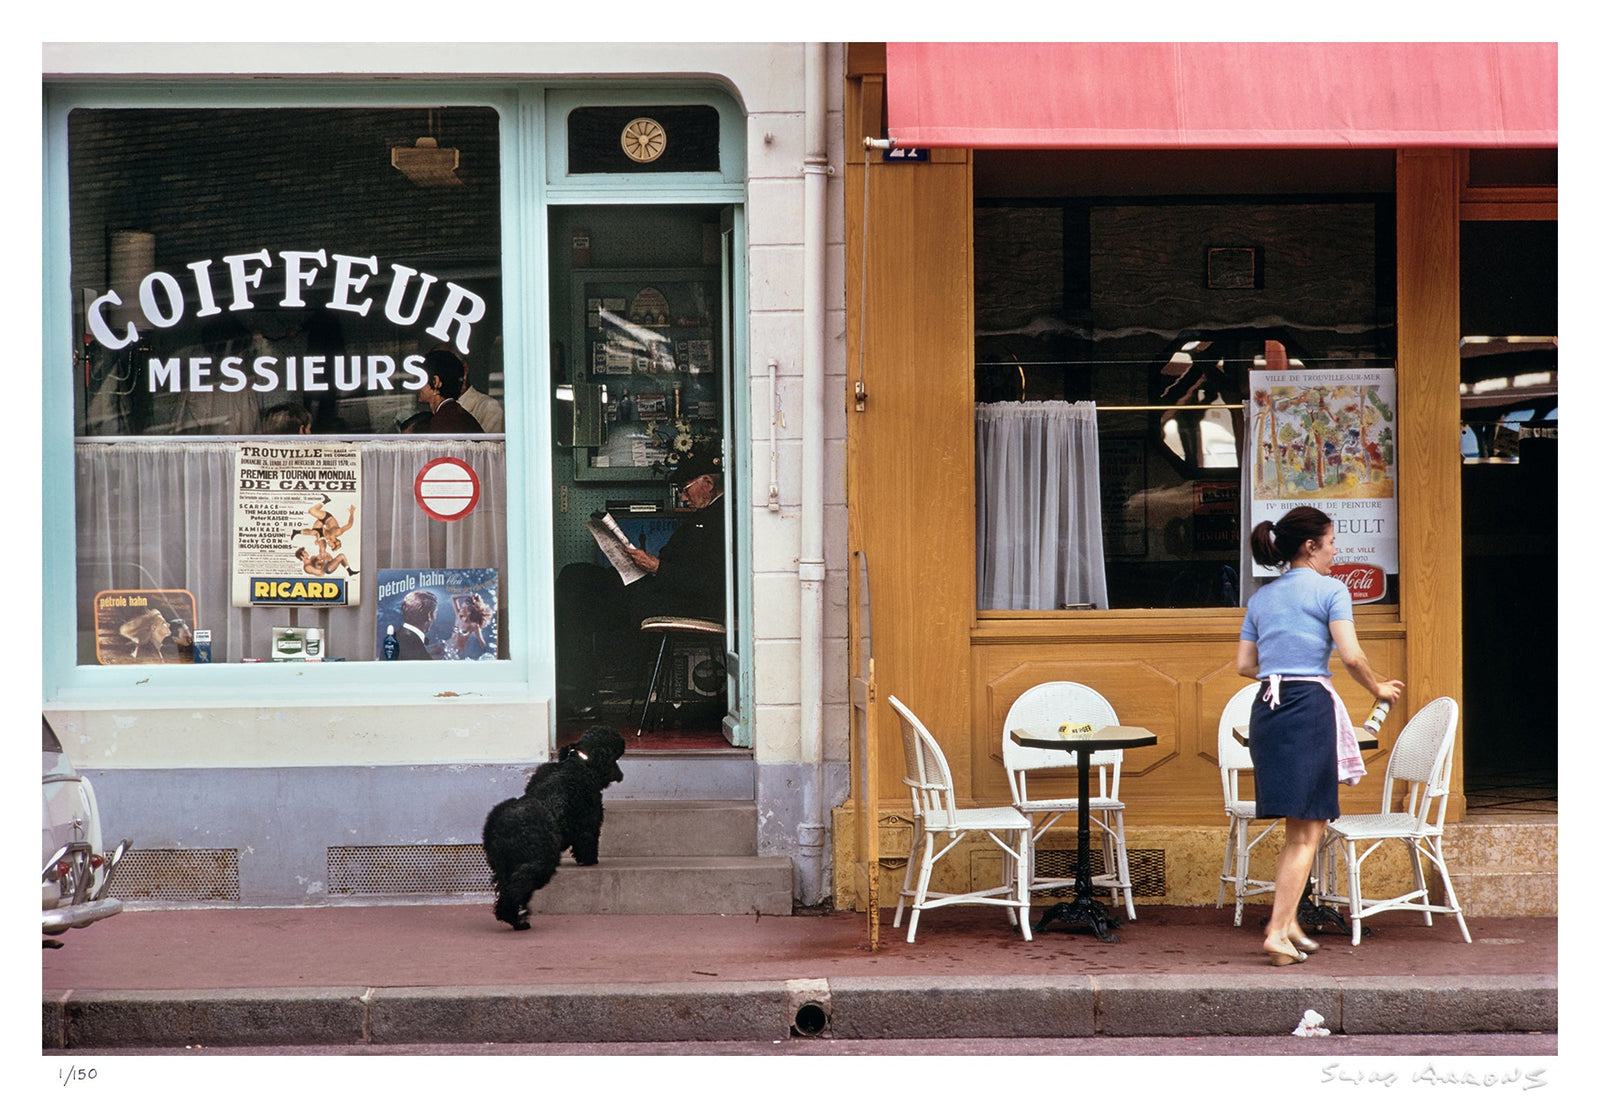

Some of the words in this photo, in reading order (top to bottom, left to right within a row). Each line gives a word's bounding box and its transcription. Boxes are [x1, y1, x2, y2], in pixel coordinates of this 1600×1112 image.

[88, 249, 486, 354] COIFFEUR
[148, 354, 429, 392] MESSIEURS
[241, 447, 322, 458] TROUVILLE
[241, 469, 278, 480] PREMIER
[281, 470, 317, 480] TOURNOI
[320, 470, 356, 481] MONDIAL
[240, 480, 270, 489] DE
[279, 480, 356, 490] CATCH
[1341, 501, 1382, 509] PEINTURE
[254, 581, 339, 598] RICARD
[379, 574, 415, 600] pétrole
[419, 571, 444, 587] hahn
[100, 596, 127, 609] pétrole
[129, 595, 147, 606] hahn
